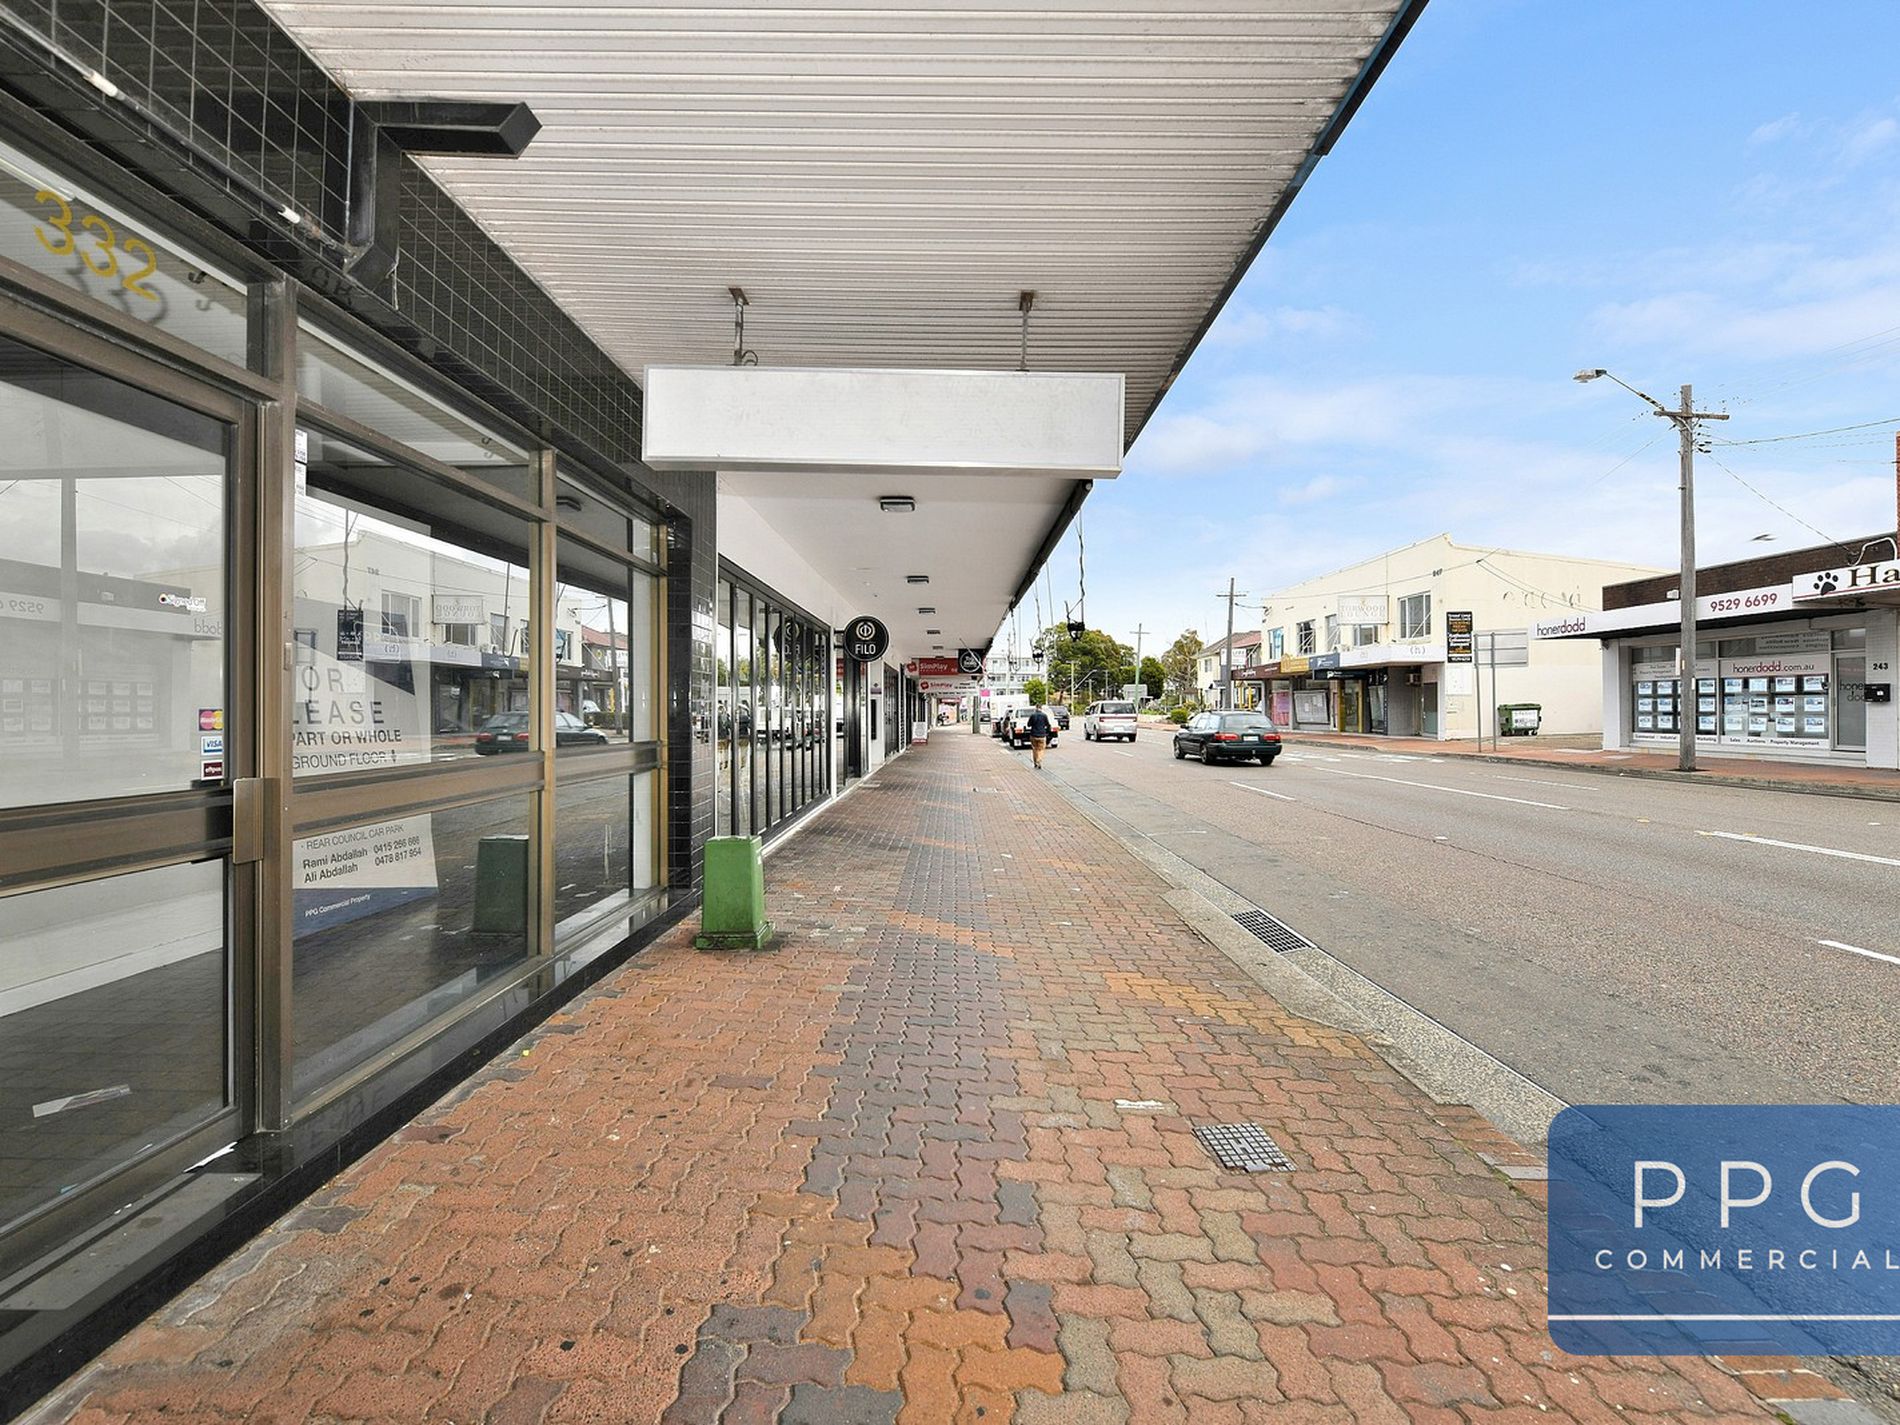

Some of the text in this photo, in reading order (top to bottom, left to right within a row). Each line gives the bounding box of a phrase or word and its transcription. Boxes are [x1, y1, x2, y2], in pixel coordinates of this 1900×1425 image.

[33, 189, 160, 303] 332
[1847, 564, 1900, 588] Ha
[1710, 592, 1778, 612] 9529 6699
[1536, 616, 1586, 636] honerdodd
[855, 643, 876, 655] FILO
[1733, 660, 1815, 673] honerdodd.com.au
[1872, 662, 1889, 671] 243
[301, 665, 345, 692] OR
[1840, 680, 1864, 691] hone
[292, 700, 385, 725] EASE
[293, 729, 402, 746] ART OR WHOLE
[293, 751, 386, 769] GROUND FLOOR
[307, 838, 331, 850] REAR
[331, 832, 368, 847] COUNCIL
[368, 827, 385, 840] CAR
[302, 856, 328, 870] Rami
[330, 848, 368, 864] Abdallah
[373, 841, 393, 854] 0415
[304, 872, 318, 884] Ali
[319, 862, 359, 881] Abdallah
[394, 850, 408, 862] 817
[305, 894, 372, 918] PPG Commercial Property
